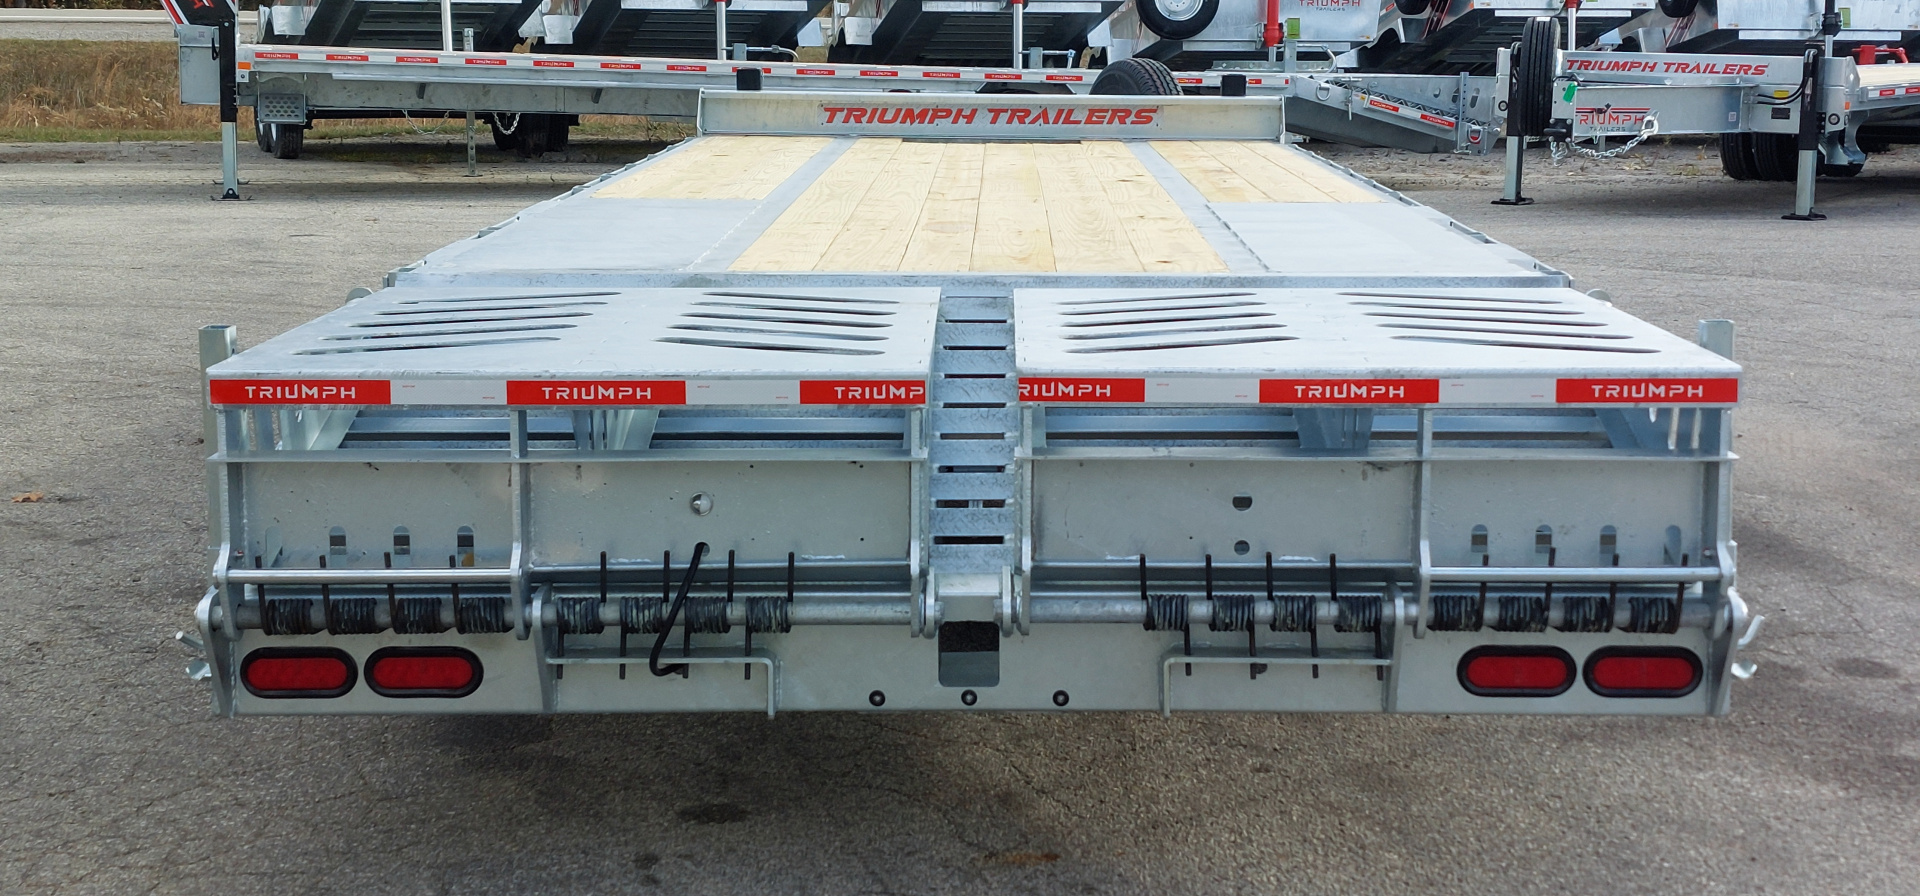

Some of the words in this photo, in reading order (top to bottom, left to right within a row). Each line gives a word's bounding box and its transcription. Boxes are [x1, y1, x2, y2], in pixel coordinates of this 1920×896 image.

[1567, 60, 1659, 72] TRIUMPH
[1663, 61, 1769, 75] TRAILERS
[823, 107, 979, 125] TRIUMPH
[987, 107, 1159, 124] TRAILERS
[1576, 112, 1646, 125] RIUMPH
[245, 384, 356, 399] TRIUMPH
[542, 384, 652, 399] TRIUMPH
[834, 384, 924, 399] TRIUMP
[1018, 382, 1111, 397] RIUMPH
[1294, 383, 1405, 398] TRIUMPH
[1591, 383, 1703, 398] TRIUMPH
